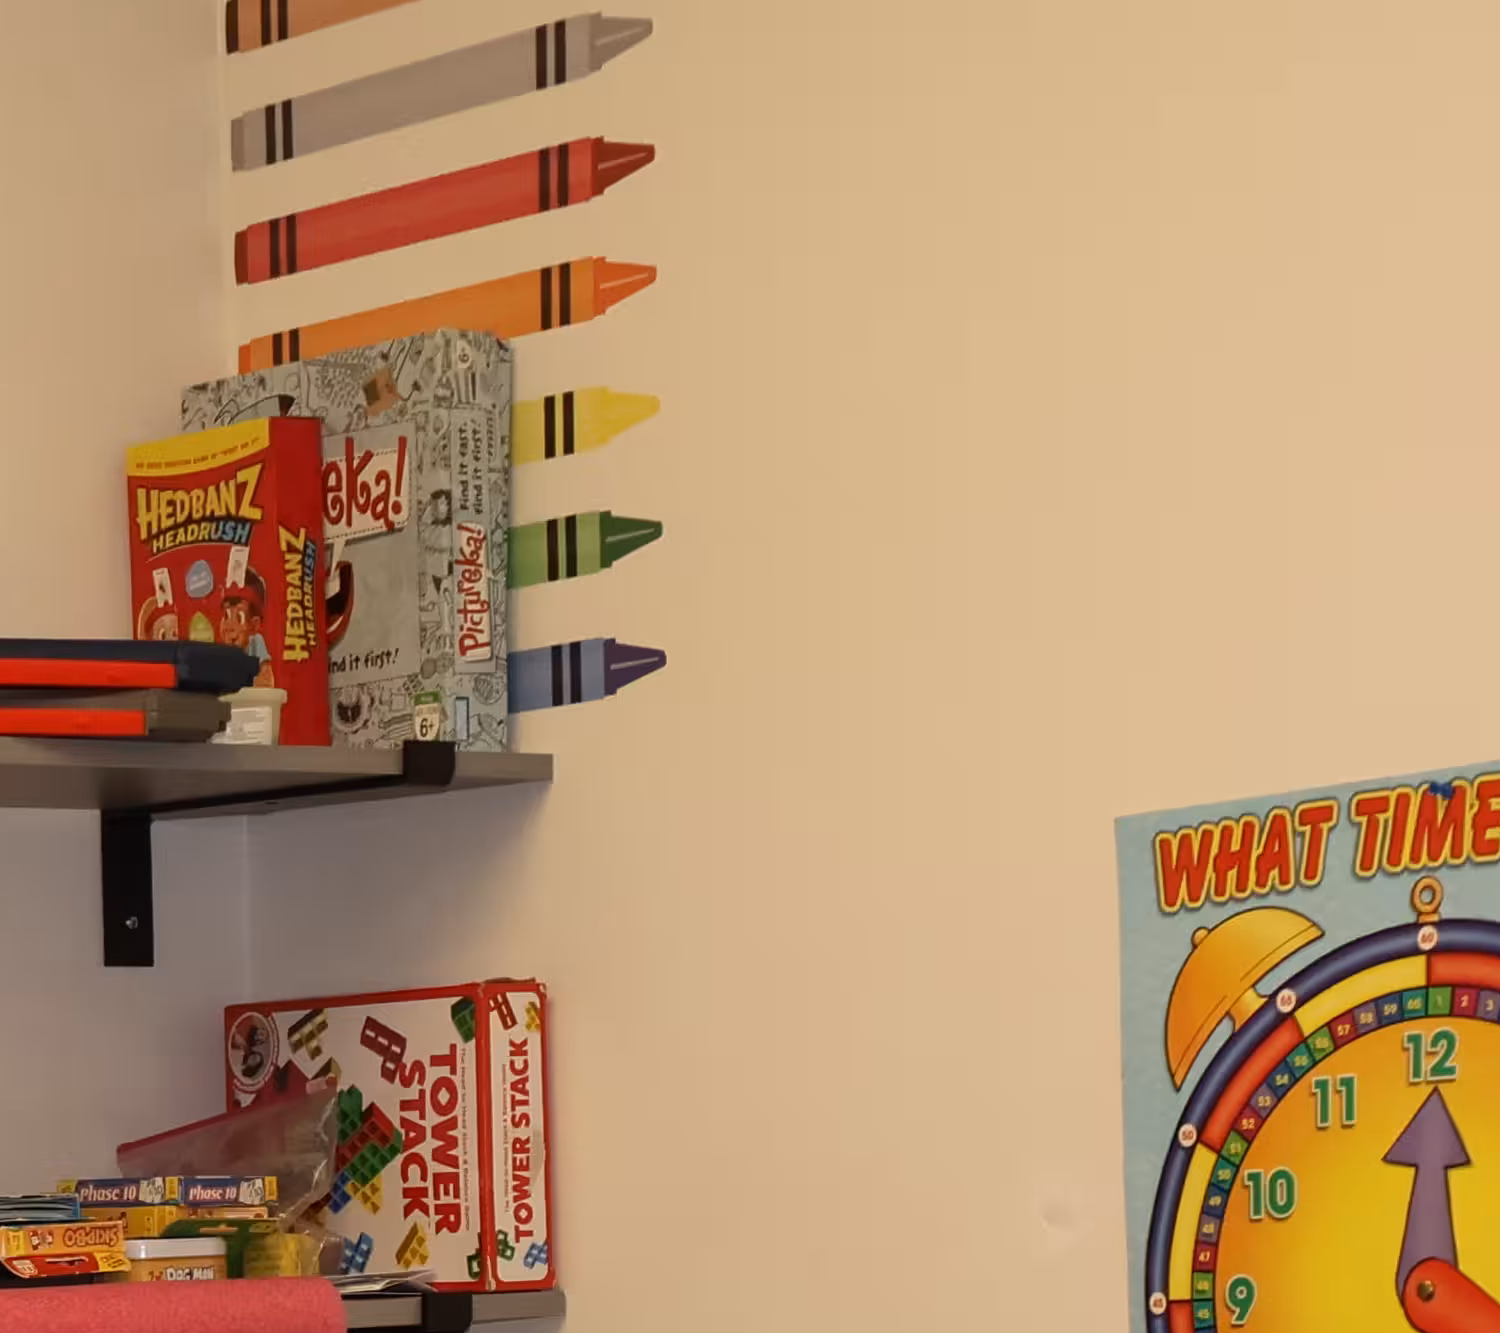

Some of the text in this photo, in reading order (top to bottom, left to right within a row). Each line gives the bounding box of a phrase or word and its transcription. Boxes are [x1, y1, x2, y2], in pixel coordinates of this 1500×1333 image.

[136, 463, 264, 541] HEDBANZ
[152, 521, 251, 554] HEADRUSH
[279, 525, 310, 662] HEDBANZ
[301, 538, 317, 647] HEADRUSH
[454, 522, 491, 657] Pictureka!
[349, 647, 400, 671] it first!
[419, 717, 435, 737] 6+
[1152, 797, 1340, 915] WHAT
[1403, 1028, 1458, 1085] 12
[1311, 1073, 1358, 1130] 11
[398, 1058, 431, 1221] STACK
[429, 1043, 463, 1236] TOWER
[508, 1037, 535, 1243] TOWER STACK
[80, 1186, 137, 1202] Phase 10
[188, 1187, 237, 1201] Phase 10
[1243, 1166, 1298, 1221] 10
[1224, 1275, 1257, 1326] 9
